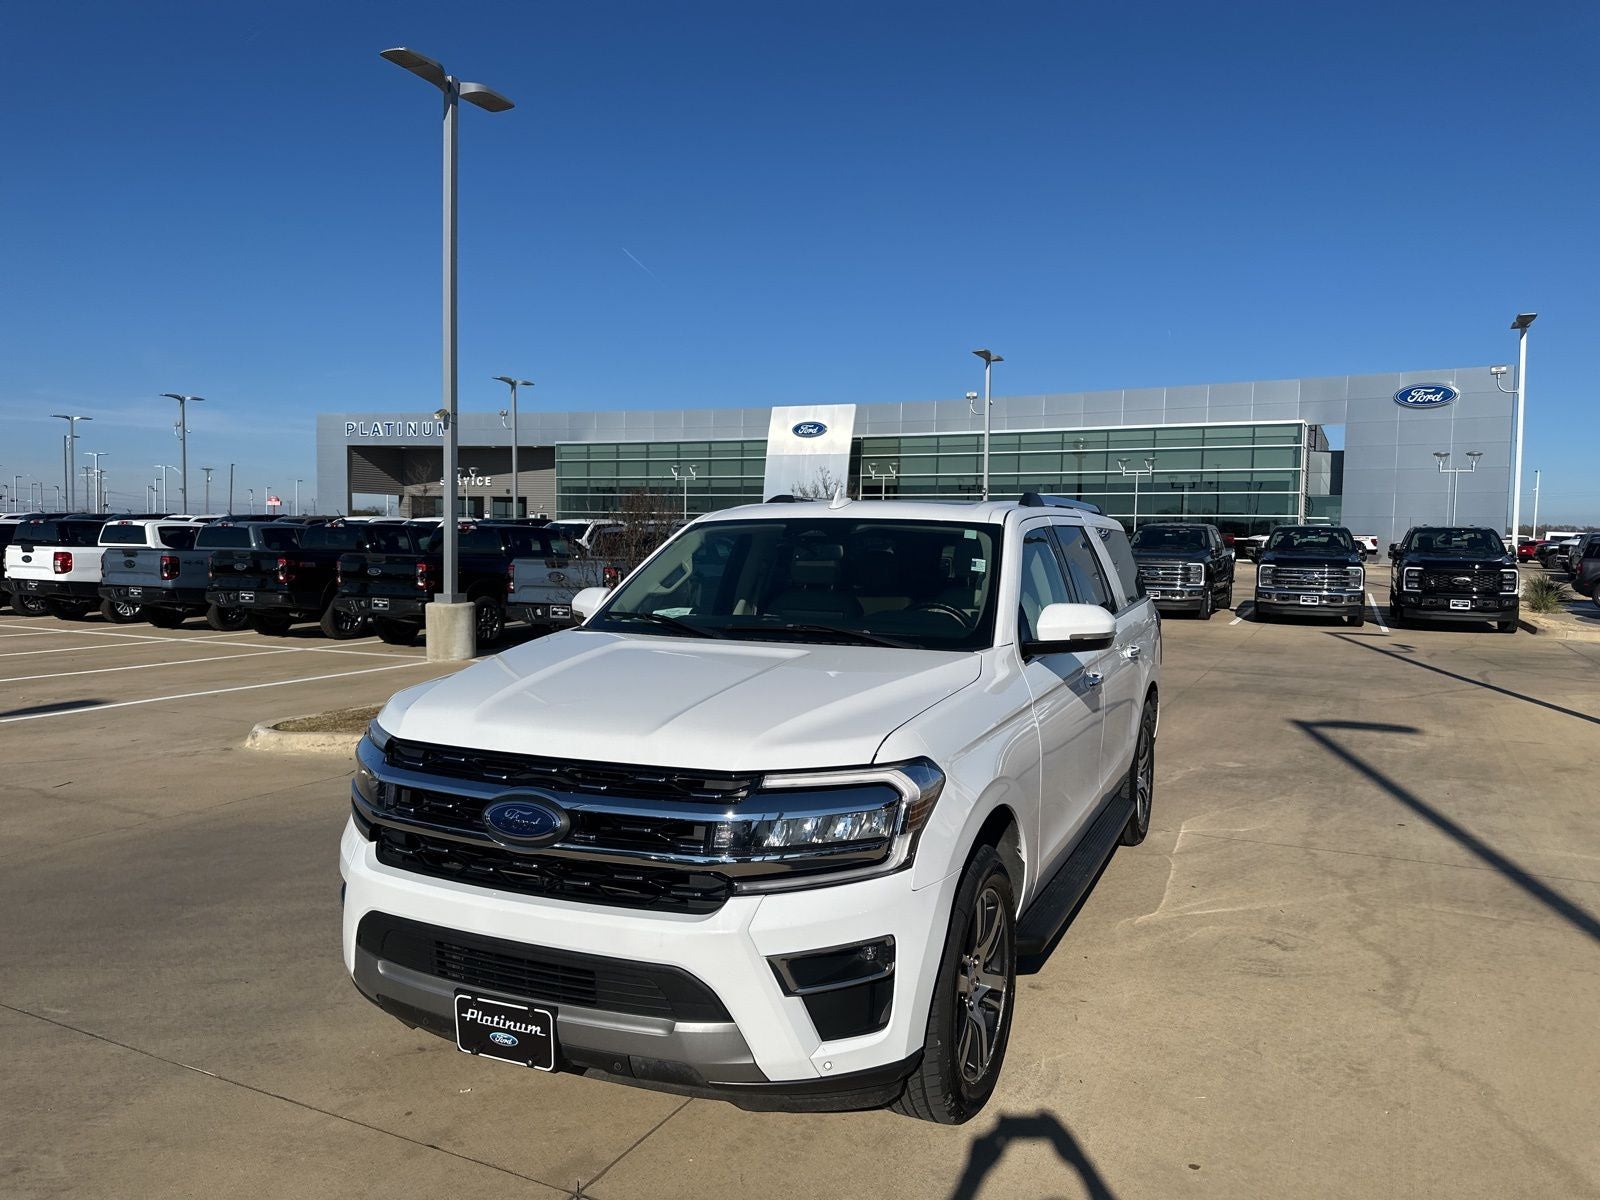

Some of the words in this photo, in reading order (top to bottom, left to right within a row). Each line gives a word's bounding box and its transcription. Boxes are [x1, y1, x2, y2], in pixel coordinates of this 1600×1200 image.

[1407, 388, 1444, 403] Ford
[440, 476, 492, 486] SRVICE
[503, 808, 541, 831] Ford
[461, 1008, 546, 1037] Platinum
[494, 1033, 513, 1045] Ford
